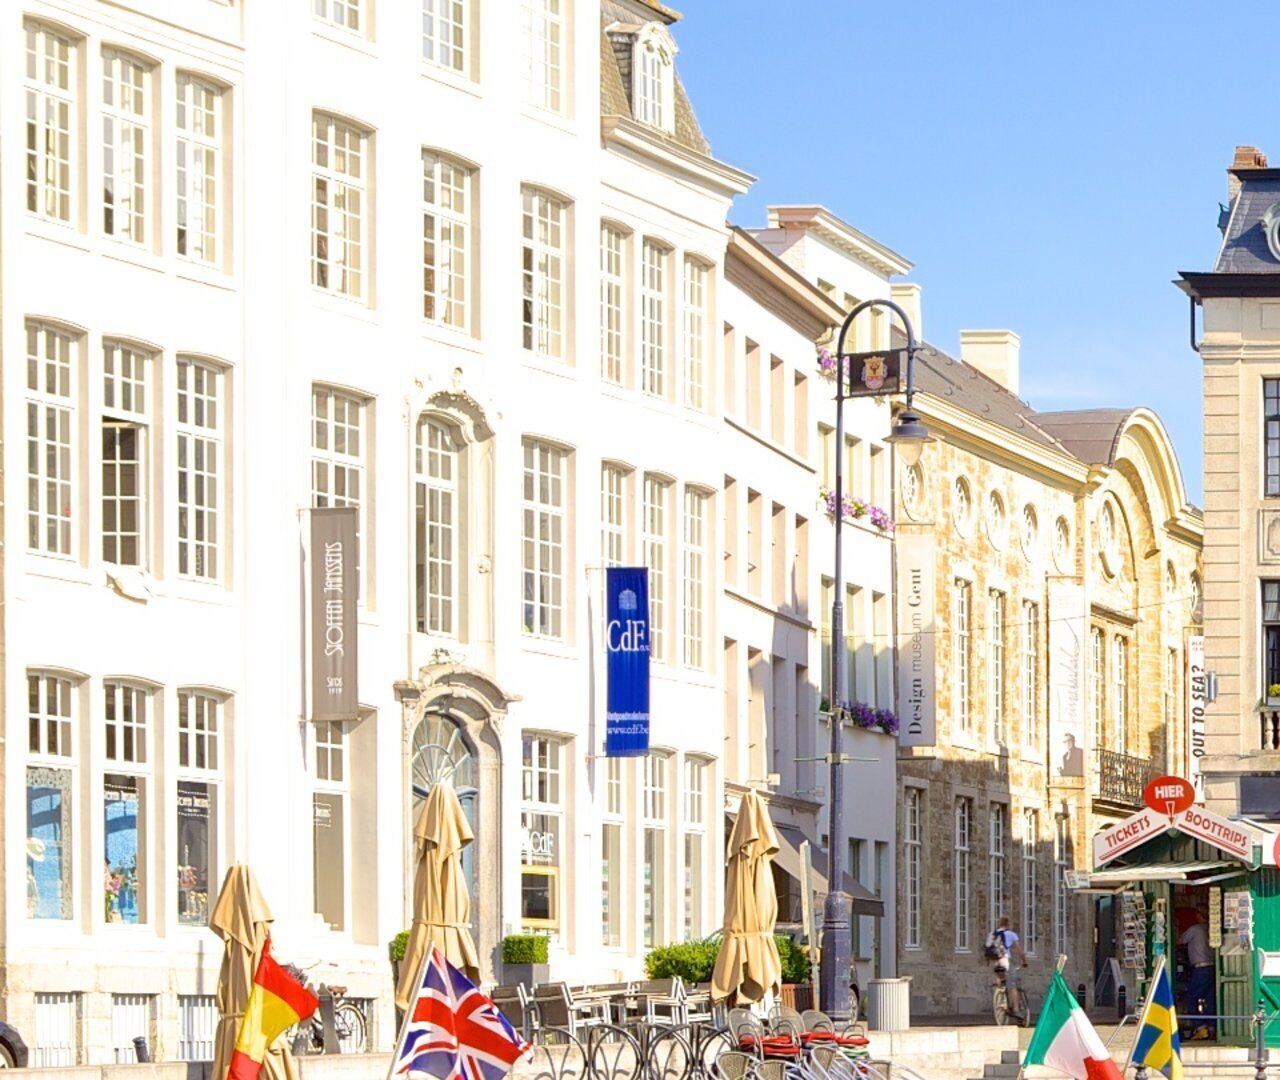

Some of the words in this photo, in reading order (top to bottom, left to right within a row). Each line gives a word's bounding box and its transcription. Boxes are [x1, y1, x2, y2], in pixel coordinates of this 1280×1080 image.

[907, 568, 922, 607] Gent
[324, 600, 344, 657] STOFFEN
[607, 620, 646, 651] CdF
[911, 612, 923, 673] museum
[907, 678, 926, 735] Design
[1192, 705, 1205, 723] TO
[1193, 728, 1205, 758] OUT
[1154, 783, 1184, 800] HIER
[1104, 814, 1151, 849] TICKETS
[1185, 809, 1248, 848] BOOTTRIPS
